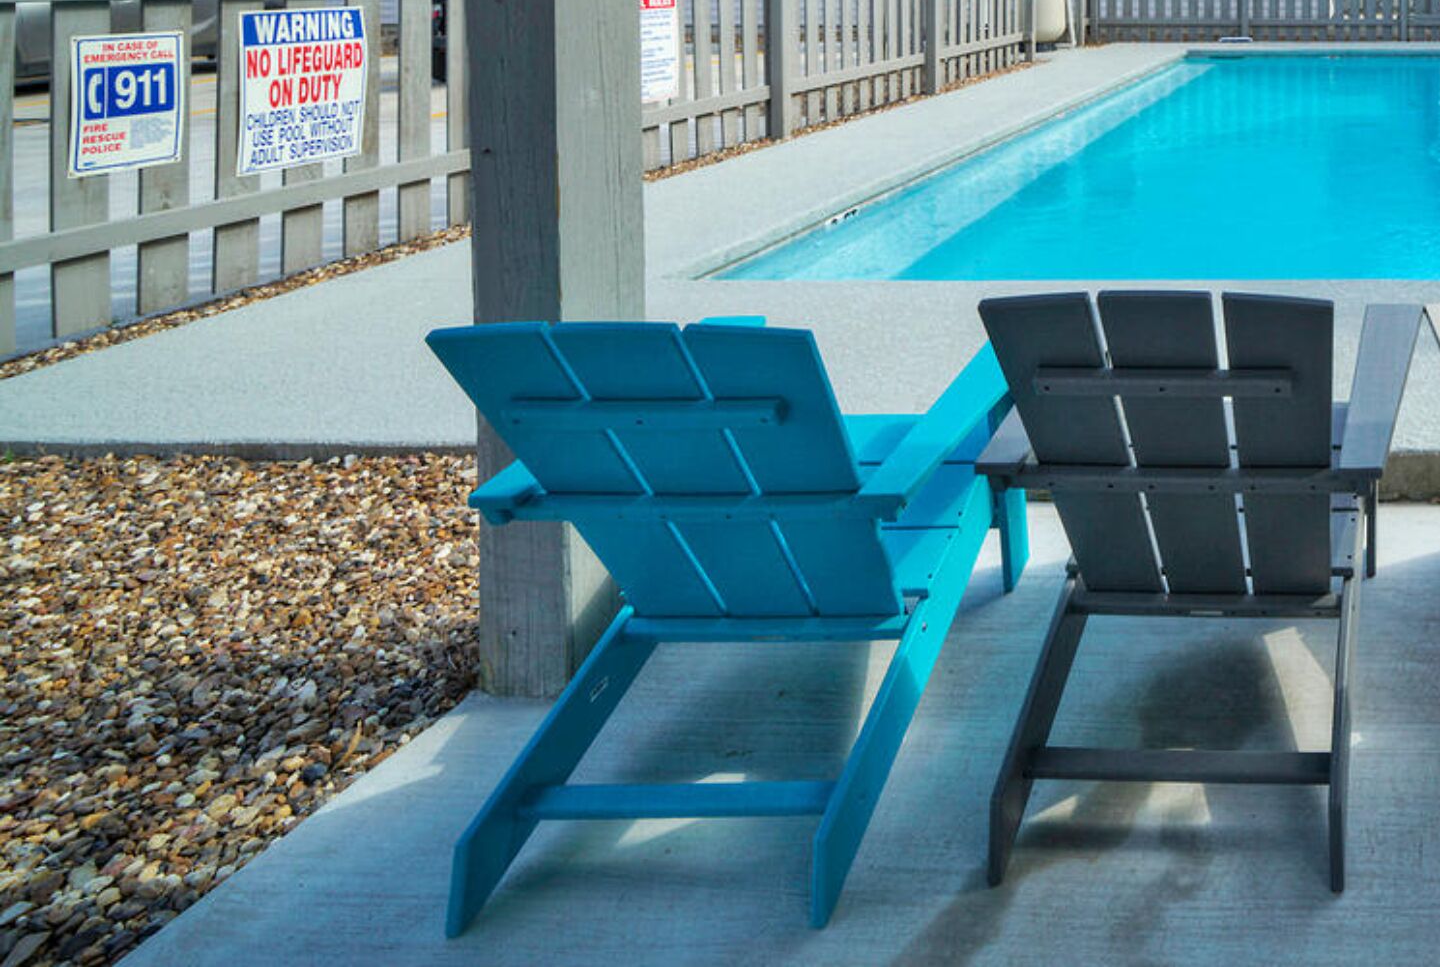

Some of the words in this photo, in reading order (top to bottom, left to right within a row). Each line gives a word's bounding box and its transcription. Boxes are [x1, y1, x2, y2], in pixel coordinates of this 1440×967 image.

[253, 11, 354, 44] WARNING
[84, 51, 148, 64] EMERGENCY
[150, 49, 175, 60] CALL
[102, 43, 115, 52] IN
[117, 41, 143, 52] CASE
[146, 40, 159, 50] OF
[246, 48, 271, 79] NO
[277, 42, 363, 76] LIFEGUARD
[115, 68, 166, 109] 911
[268, 78, 293, 108] ON
[297, 73, 343, 104] DUTY
[83, 123, 108, 133] FIRE
[247, 108, 295, 131] CHILDREN
[301, 102, 338, 123] SHOULD
[342, 100, 360, 121] NOT
[82, 131, 126, 144] RESCUE
[253, 129, 273, 148] USE
[279, 125, 306, 143] POOL
[310, 118, 353, 137] WITHOUT
[81, 143, 122, 155] POLICE
[250, 145, 285, 165] ADULT
[289, 135, 353, 160] SUPERVISION
